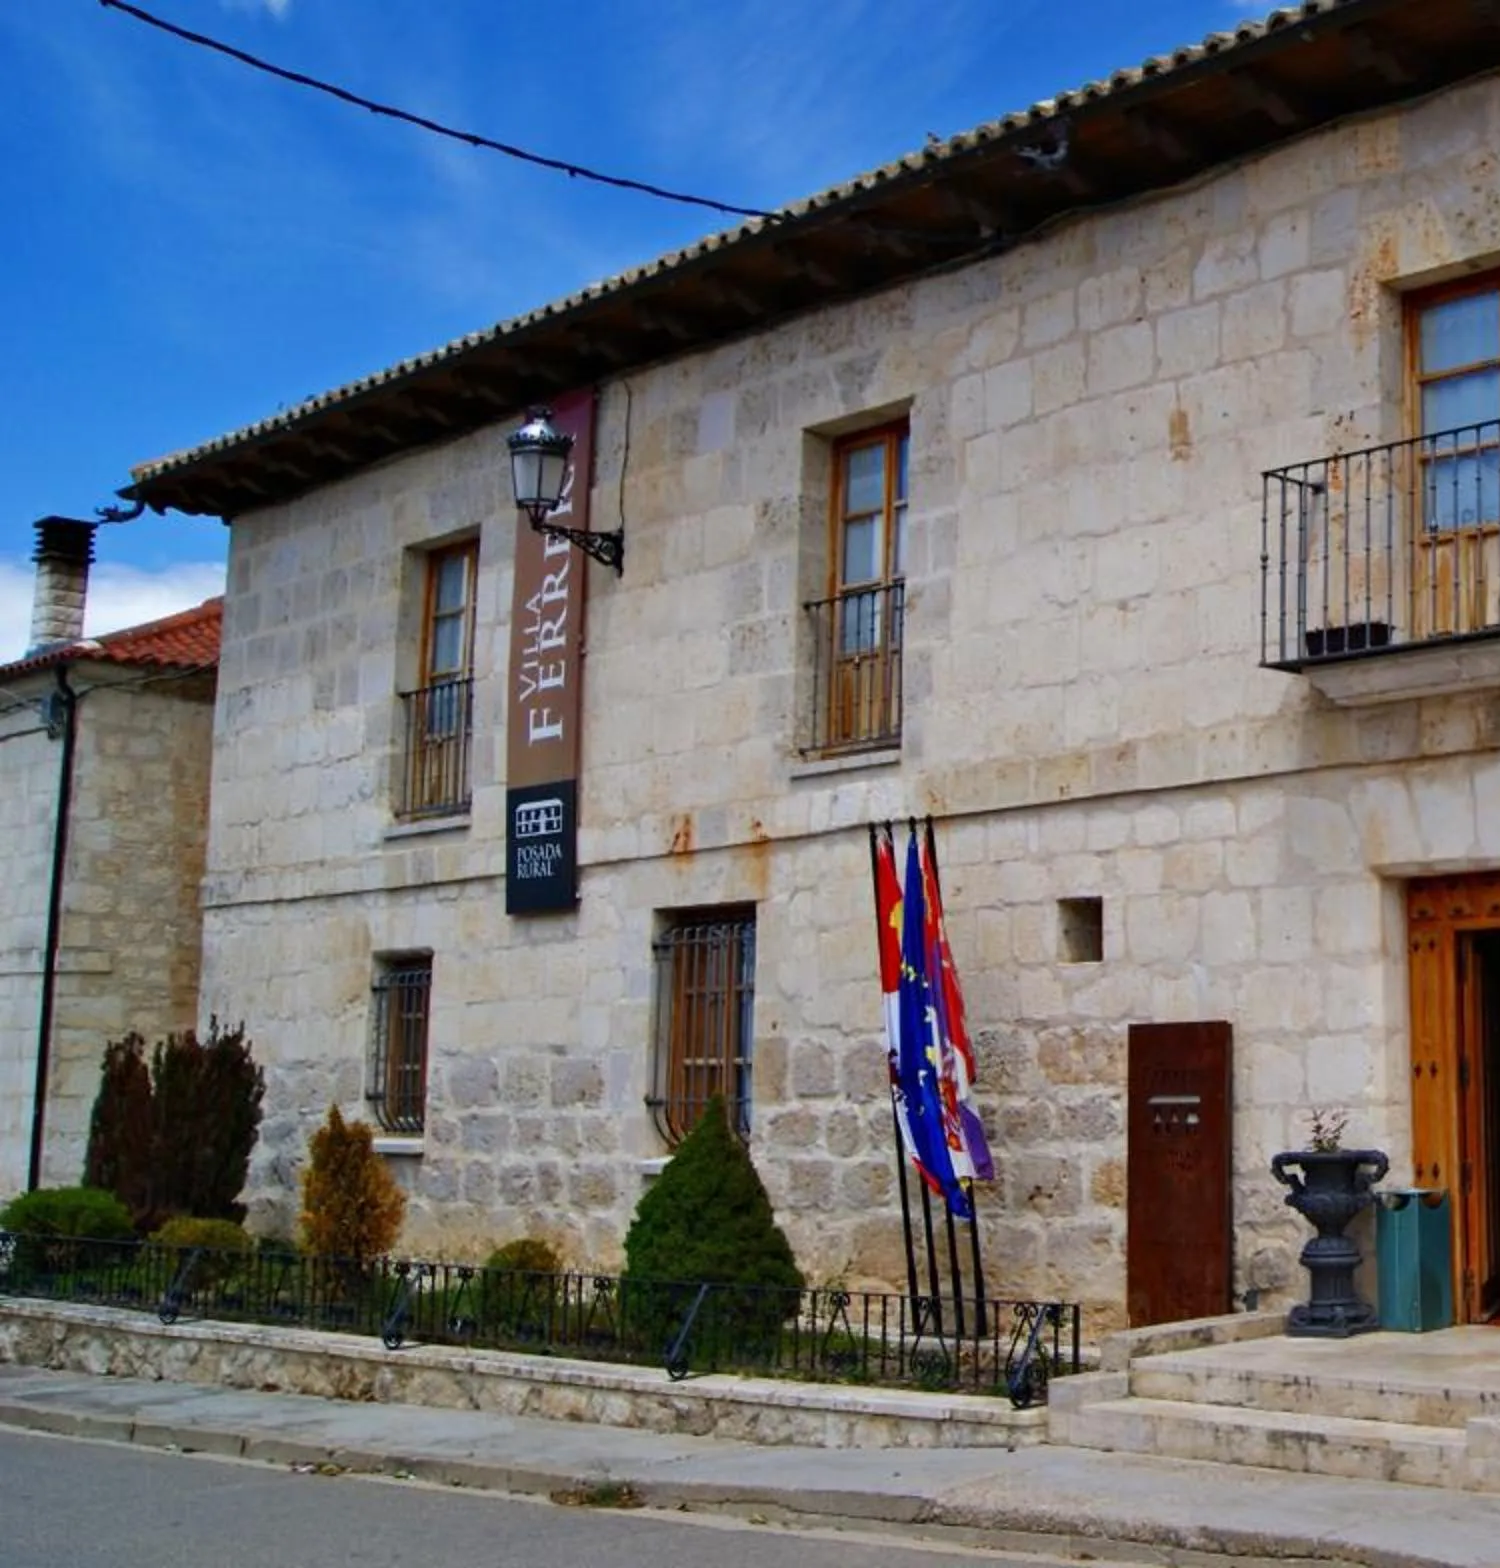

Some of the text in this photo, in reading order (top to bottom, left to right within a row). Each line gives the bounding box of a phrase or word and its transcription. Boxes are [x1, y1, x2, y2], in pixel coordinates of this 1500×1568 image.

[519, 592, 541, 702] VILLA
[518, 843, 562, 863] POSADA
[517, 860, 555, 879] RURAL
